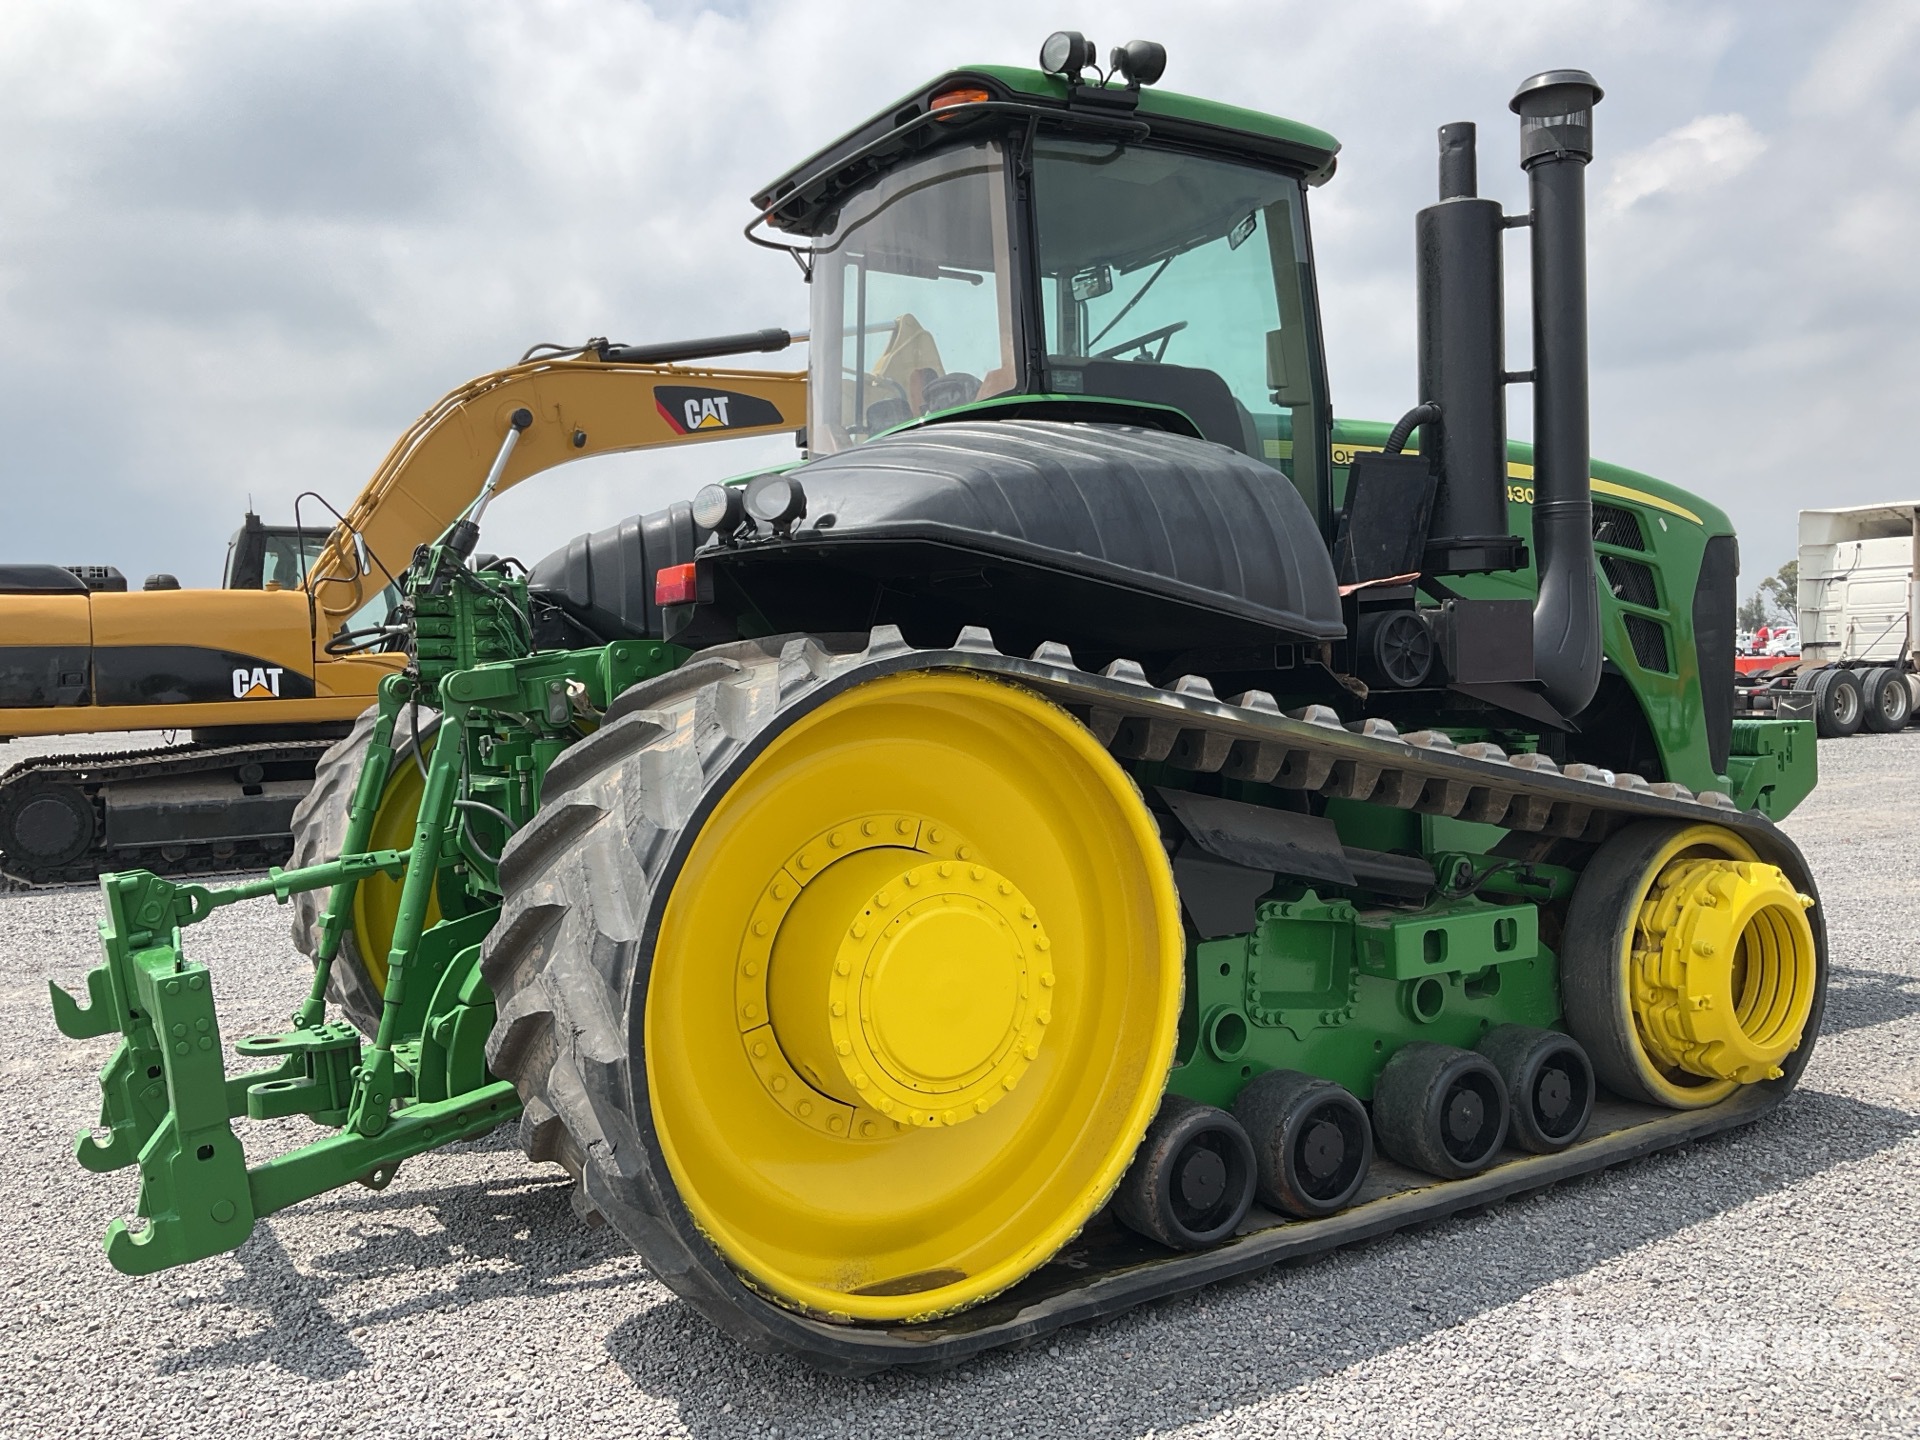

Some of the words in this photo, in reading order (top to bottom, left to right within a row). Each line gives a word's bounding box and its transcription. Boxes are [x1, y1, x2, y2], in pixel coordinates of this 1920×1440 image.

[684, 396, 729, 429] CAT
[1333, 450, 1355, 463] OH
[1507, 485, 1534, 505] 430
[232, 667, 283, 698] CAT
